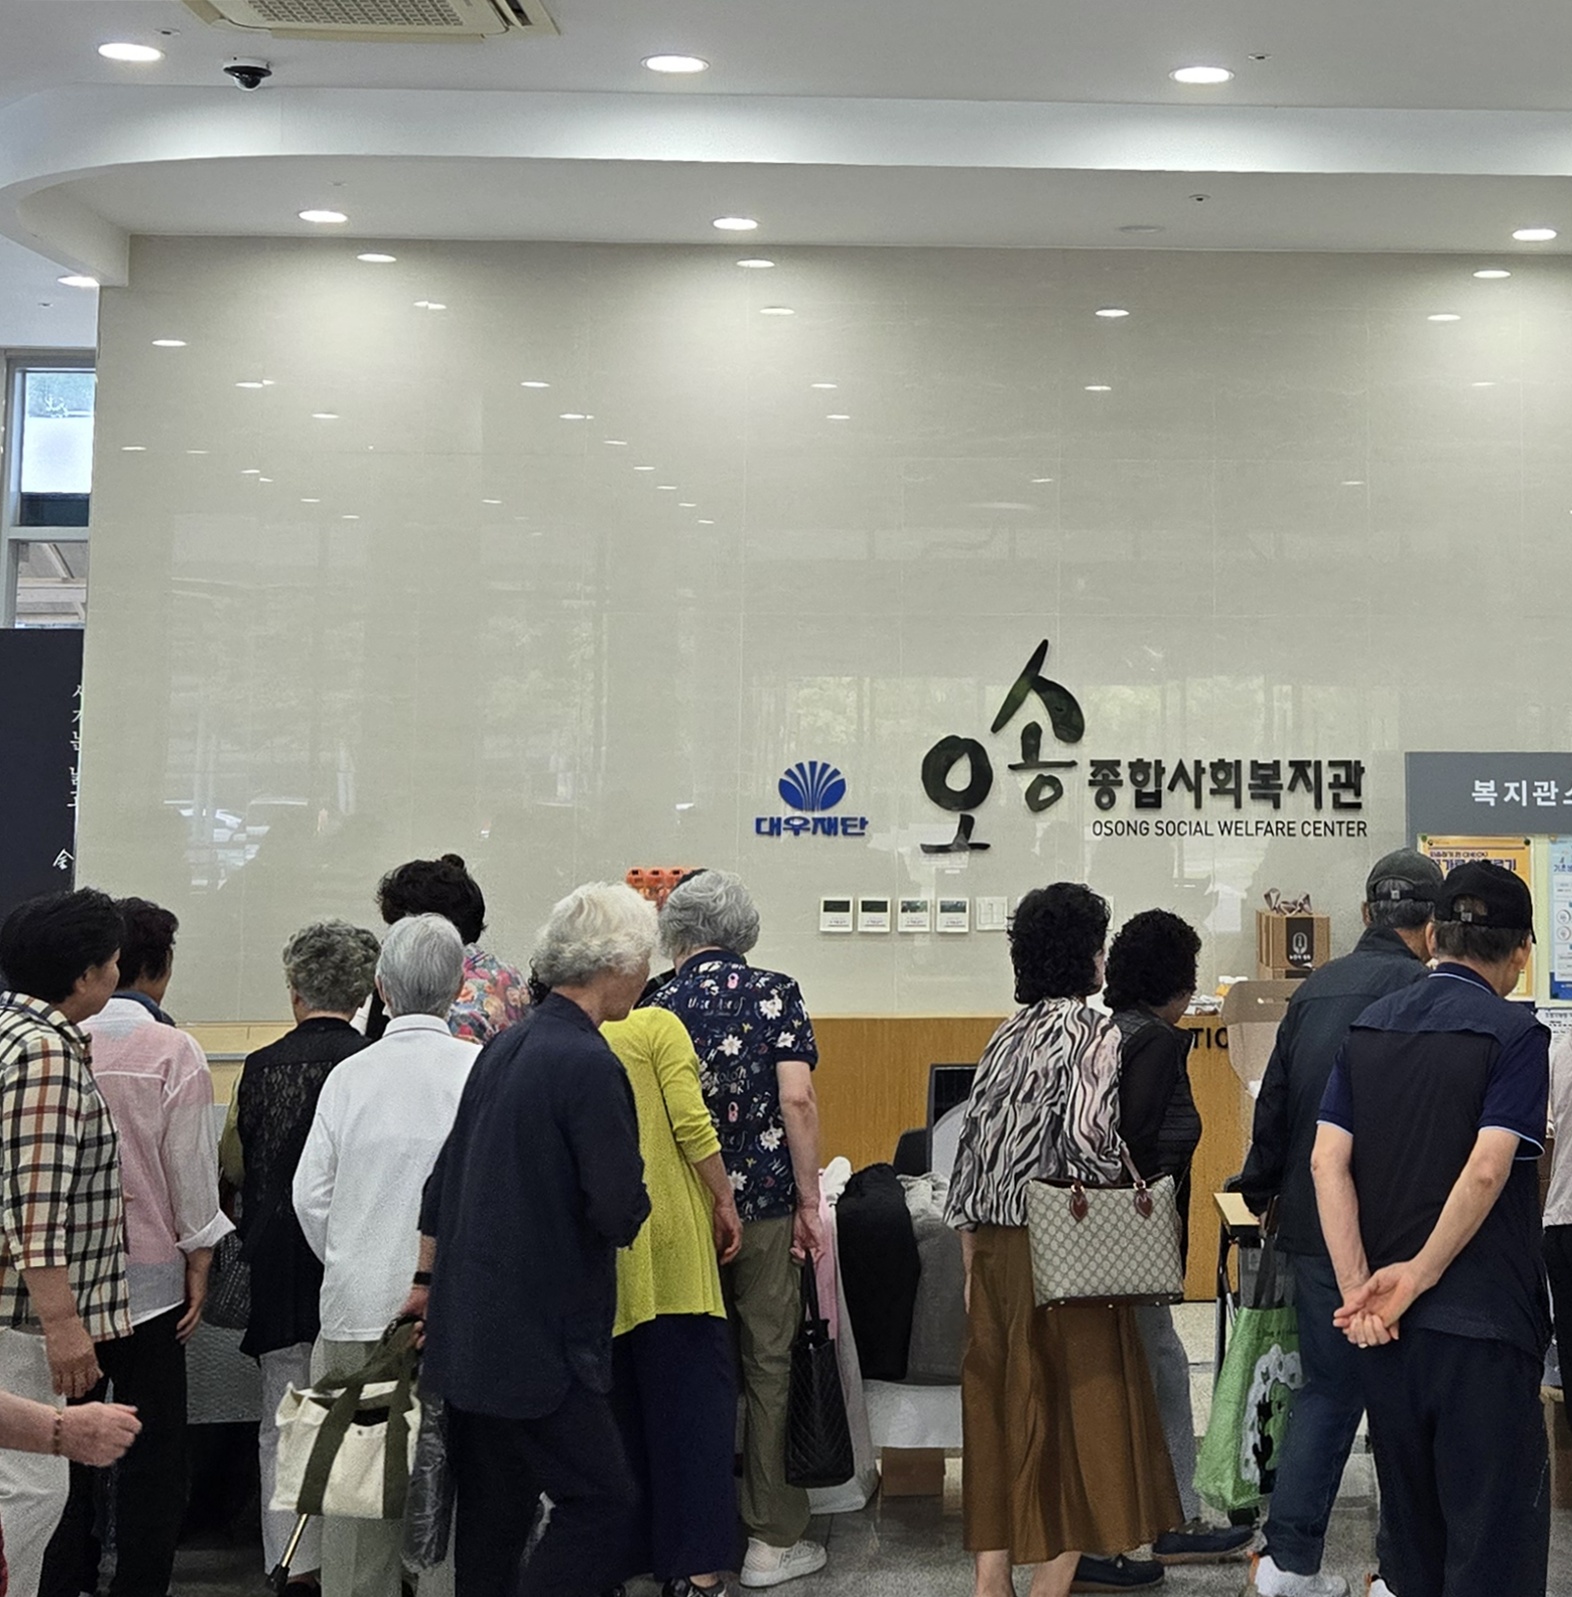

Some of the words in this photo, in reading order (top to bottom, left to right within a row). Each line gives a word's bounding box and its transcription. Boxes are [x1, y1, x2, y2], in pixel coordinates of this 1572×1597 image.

[1088, 758, 1366, 811] 종합사회복지관
[755, 815, 869, 837] 대우재단
[1092, 820, 1149, 837] OSONG
[1154, 820, 1214, 837] SOCIAL
[1217, 820, 1296, 837] WELFARE
[1301, 820, 1367, 837] CENTER
